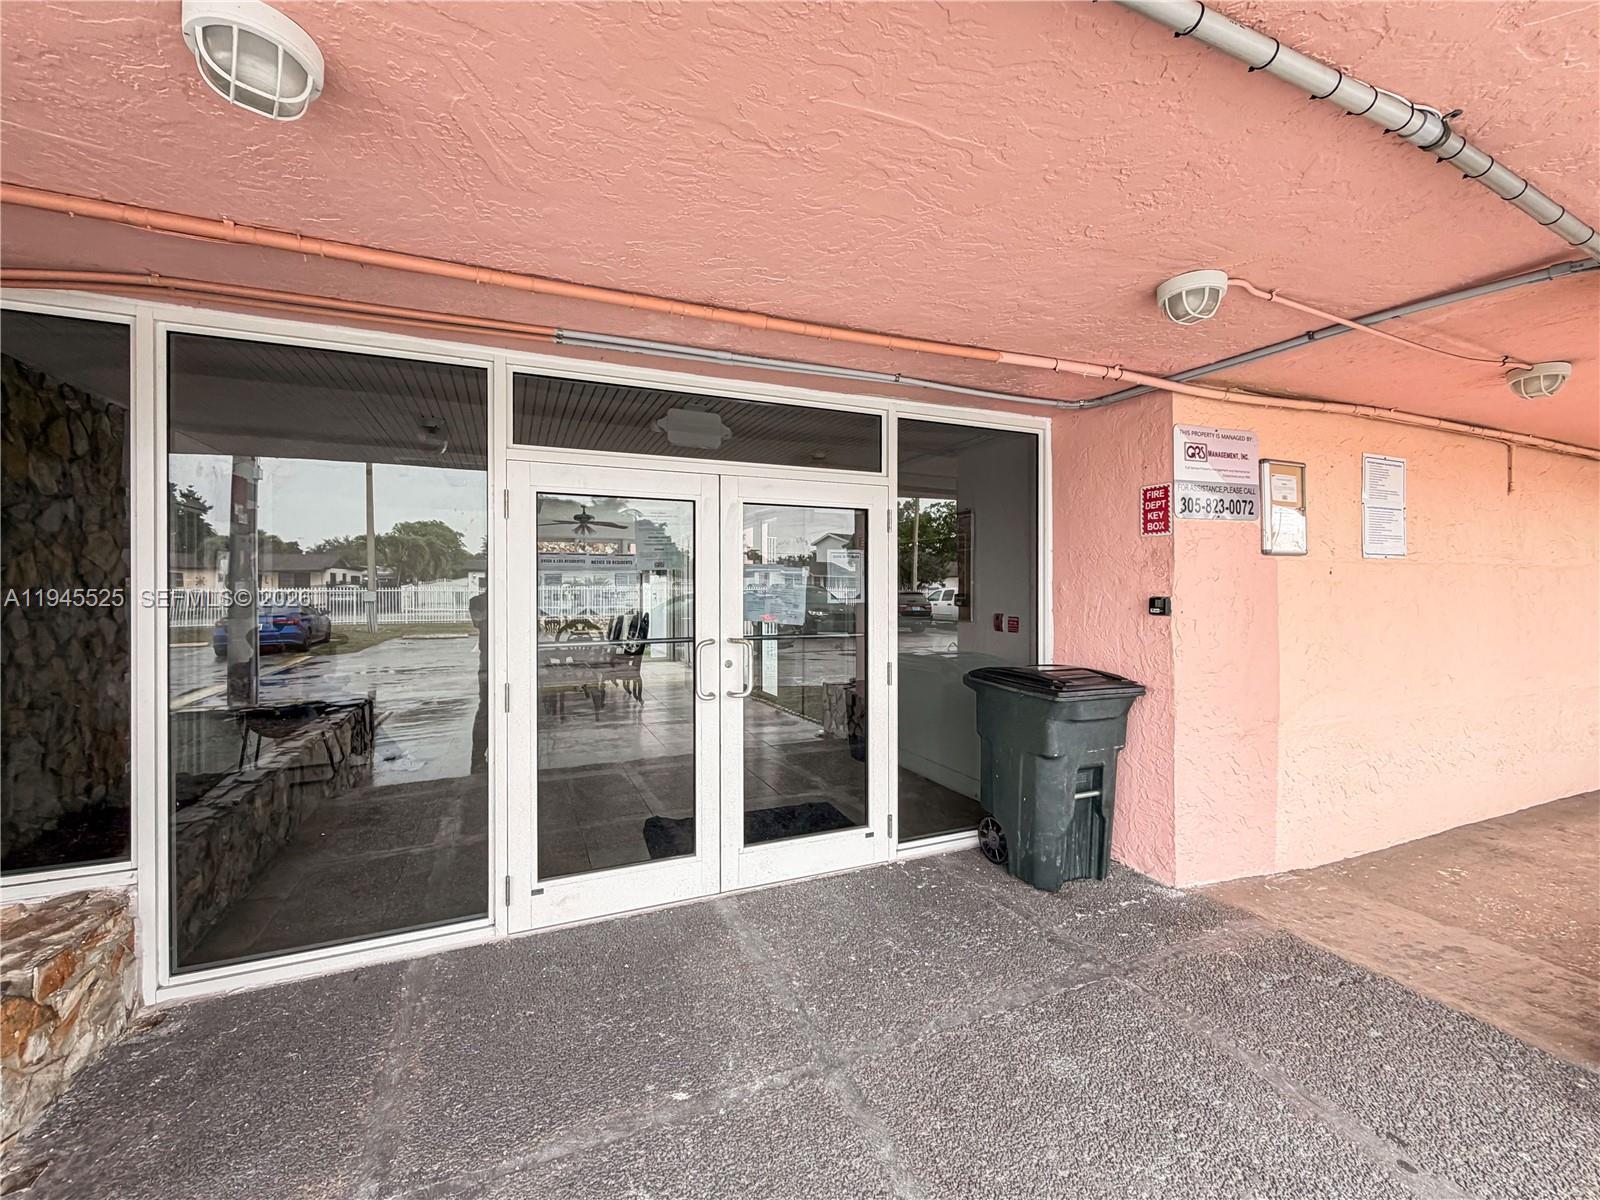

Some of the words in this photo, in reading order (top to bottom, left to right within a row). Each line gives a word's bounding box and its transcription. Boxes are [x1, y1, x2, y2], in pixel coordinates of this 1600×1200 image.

[1180, 428, 1191, 436] THIS
[1191, 430, 1215, 438] PROPERTY
[1221, 433, 1246, 441] MANAGED
[1186, 444, 1206, 460] GRS
[1207, 450, 1241, 460] MANAGEMENT,
[1146, 489, 1165, 500] FIRE
[1177, 483, 1189, 492] FOR
[1243, 487, 1256, 495] CALL
[1145, 500, 1167, 510] DEPT
[1179, 497, 1255, 515] 305-823-0072
[1147, 511, 1165, 520] KEY
[1147, 521, 1165, 531] BOX
